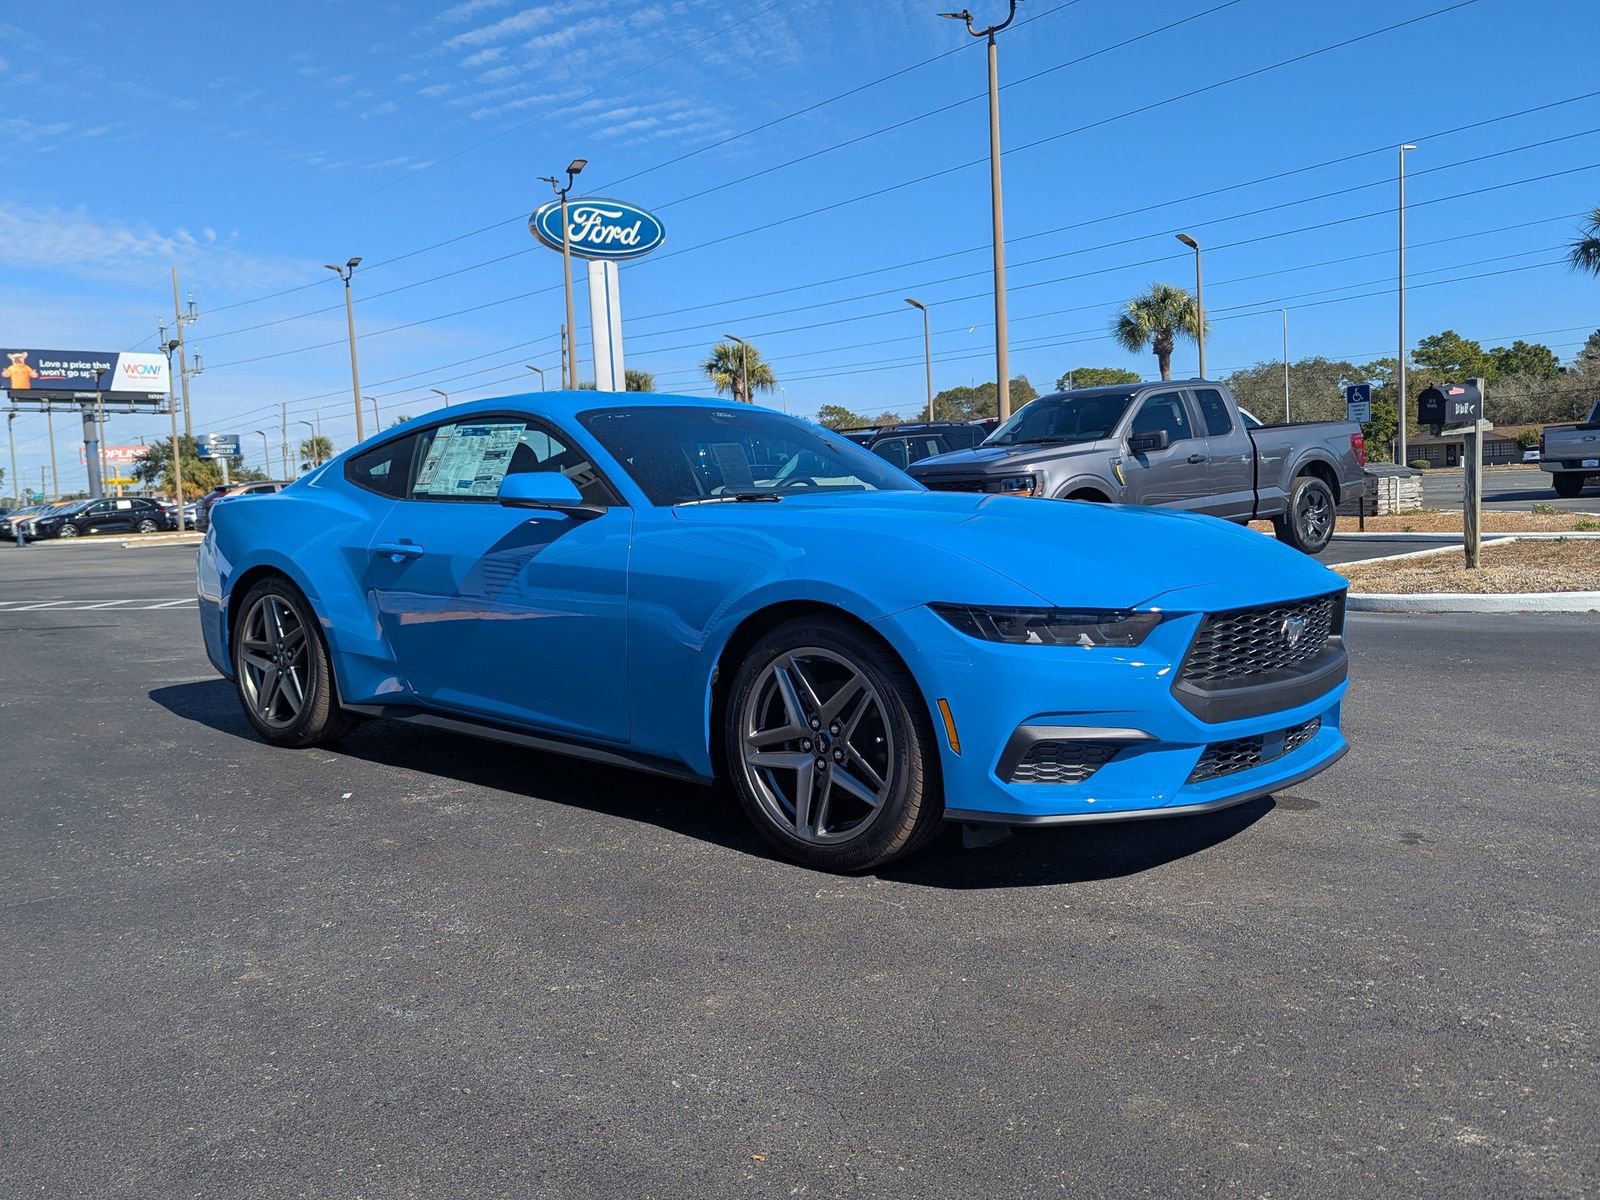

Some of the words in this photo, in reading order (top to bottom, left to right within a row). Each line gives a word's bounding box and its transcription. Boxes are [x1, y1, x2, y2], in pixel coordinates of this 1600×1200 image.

[568, 207, 641, 245] Ford
[39, 359, 61, 368] Love
[69, 360, 91, 369] price
[92, 361, 111, 370] that
[122, 363, 161, 375] WOW!
[67, 370, 79, 378] go
